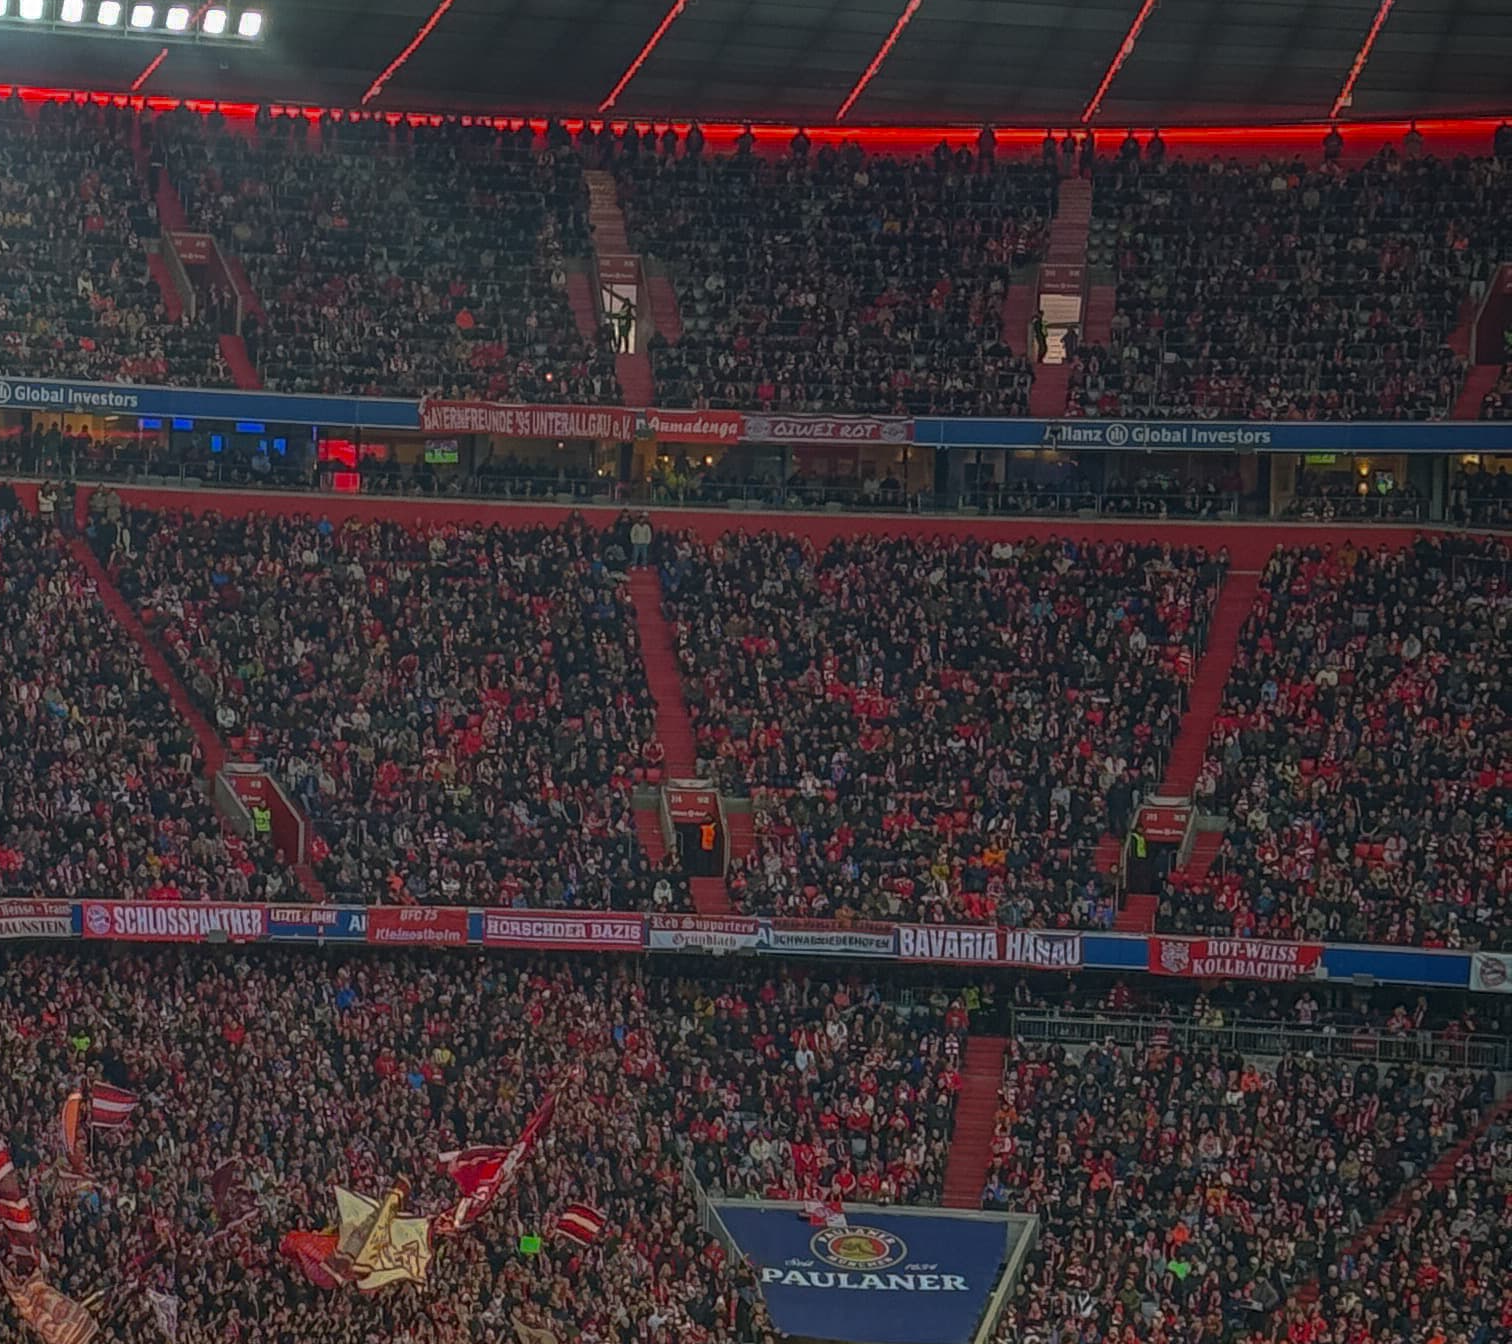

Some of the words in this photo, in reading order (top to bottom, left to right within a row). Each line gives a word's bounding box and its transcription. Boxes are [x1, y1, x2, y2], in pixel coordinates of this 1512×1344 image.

[13, 383, 65, 405] Global
[68, 388, 139, 408] Investors
[840, 423, 878, 438] ROT
[1042, 424, 1103, 444] Allianz
[1131, 424, 1187, 446] Global
[1191, 426, 1271, 446] Investors
[112, 905, 264, 937] SCHLOSSPANTHER
[487, 918, 587, 941] HORSCHDER
[591, 922, 641, 942] DAZIS
[682, 917, 755, 934] Supporters
[898, 926, 999, 961] BAVARIA
[1005, 931, 1083, 966] HANAU
[1206, 939, 1300, 962] ROT-WEISS
[817, 1226, 897, 1246] PAULANER
[826, 1254, 894, 1269] MÜNCHEN
[761, 1266, 970, 1292] PAULANER
